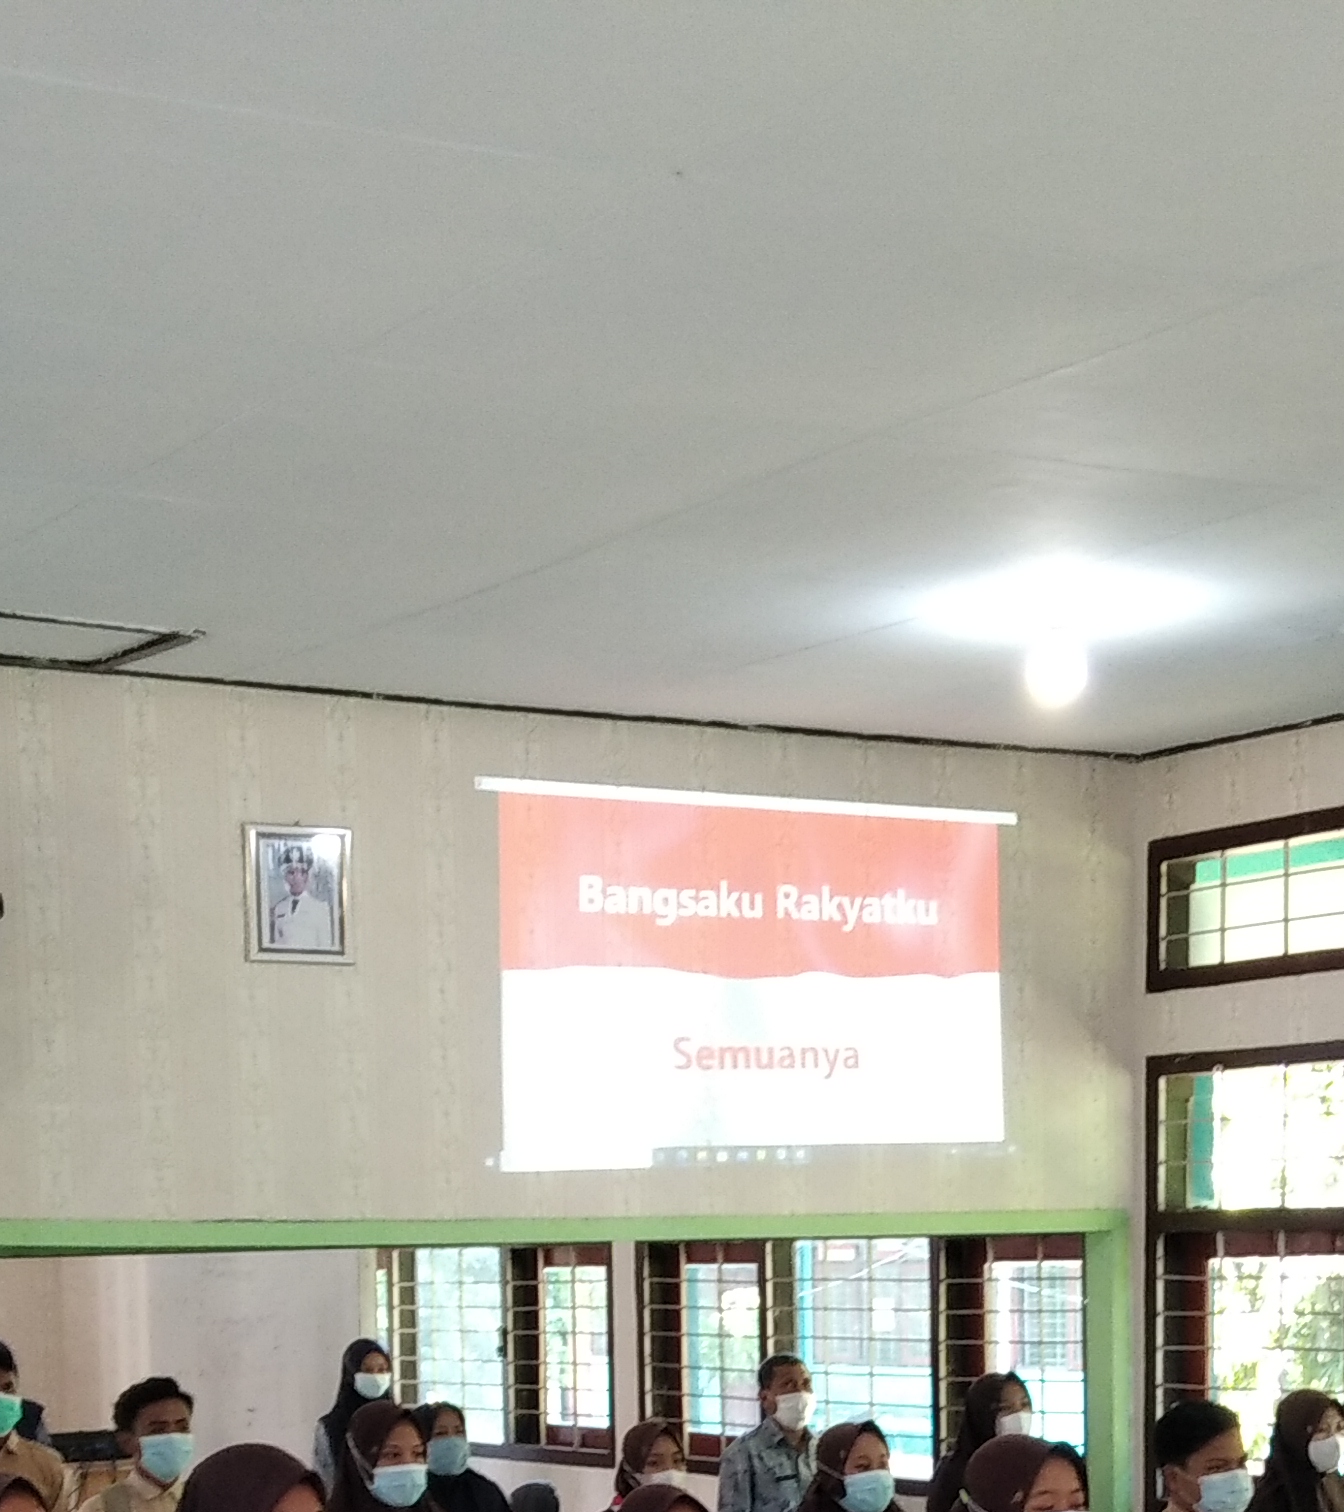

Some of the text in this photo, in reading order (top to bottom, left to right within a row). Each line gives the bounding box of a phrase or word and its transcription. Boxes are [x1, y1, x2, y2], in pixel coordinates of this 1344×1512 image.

[578, 875, 938, 932] Bangsaku Rakyatku
[672, 1037, 861, 1079] Semuanya
